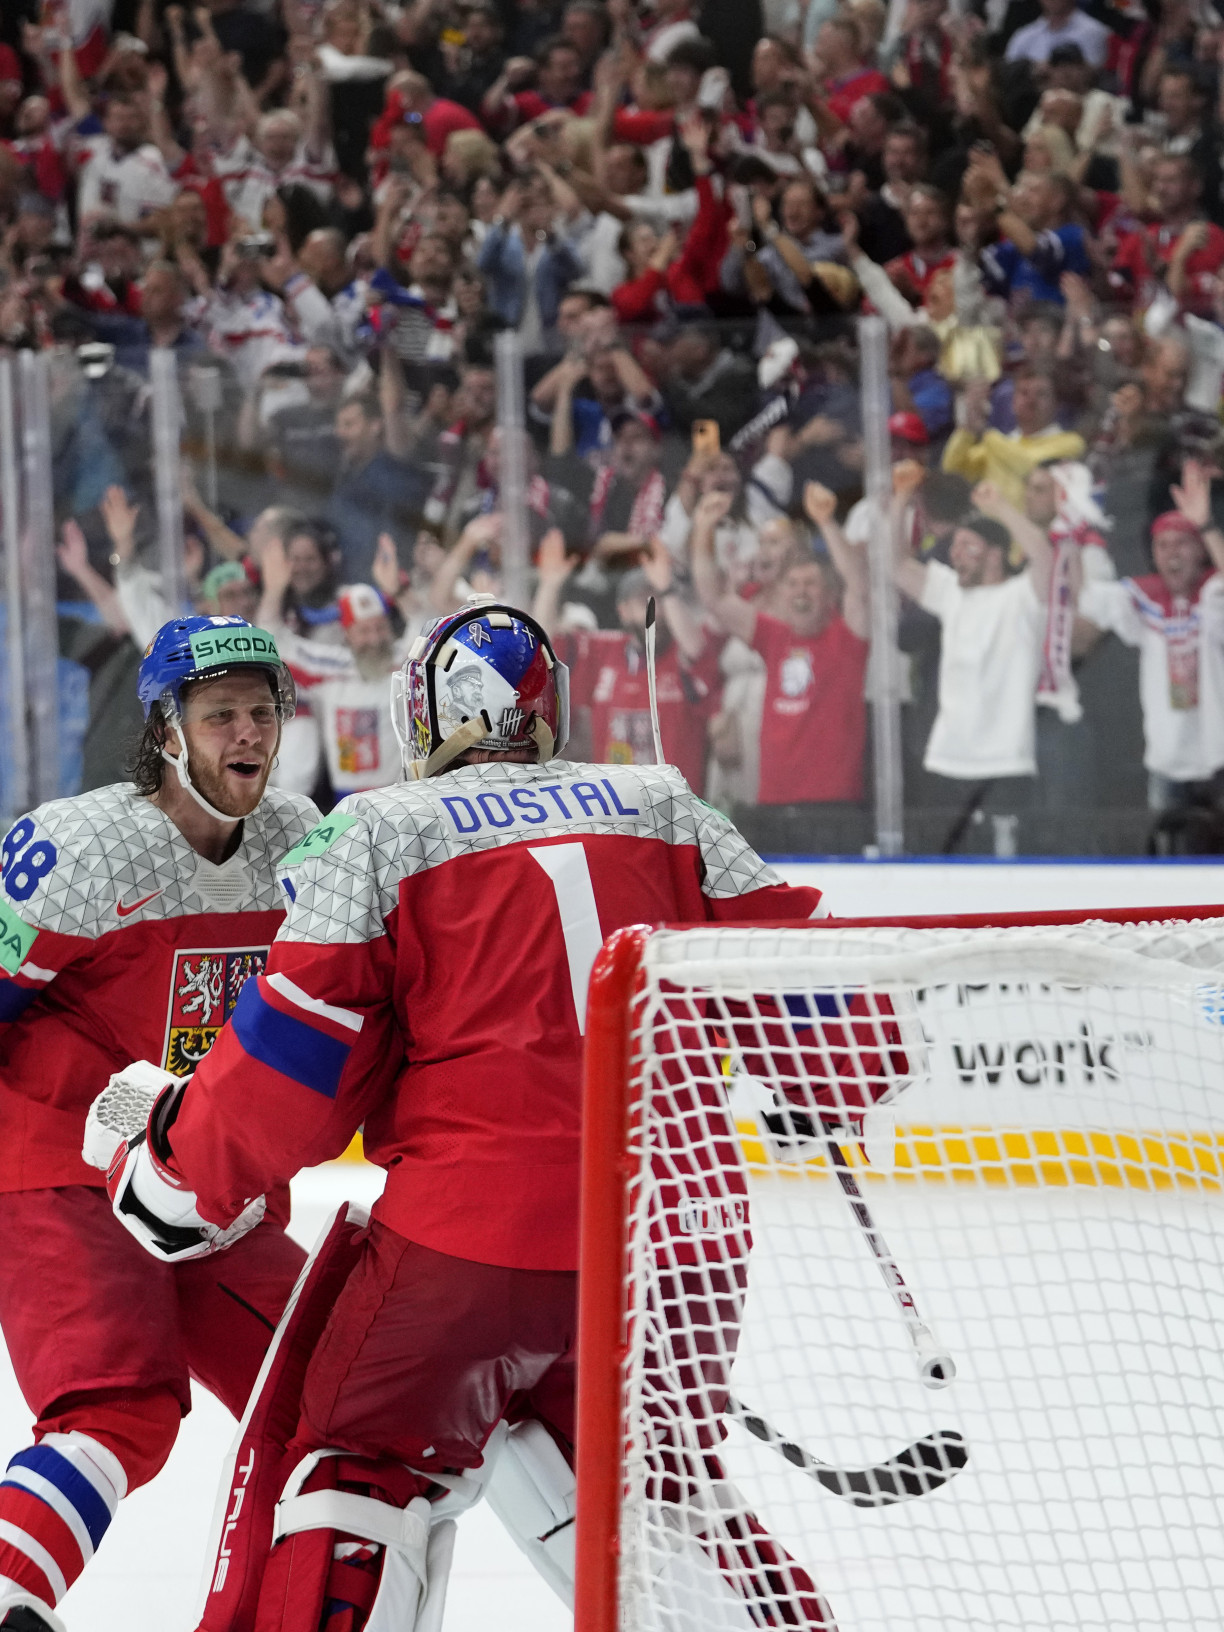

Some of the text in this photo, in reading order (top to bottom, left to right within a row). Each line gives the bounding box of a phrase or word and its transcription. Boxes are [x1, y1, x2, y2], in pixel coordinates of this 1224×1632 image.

[2, 817, 57, 902] 88
[440, 778, 640, 834] DOSTAL
[527, 841, 604, 1037] 1
[212, 1447, 255, 1593] TRUE
